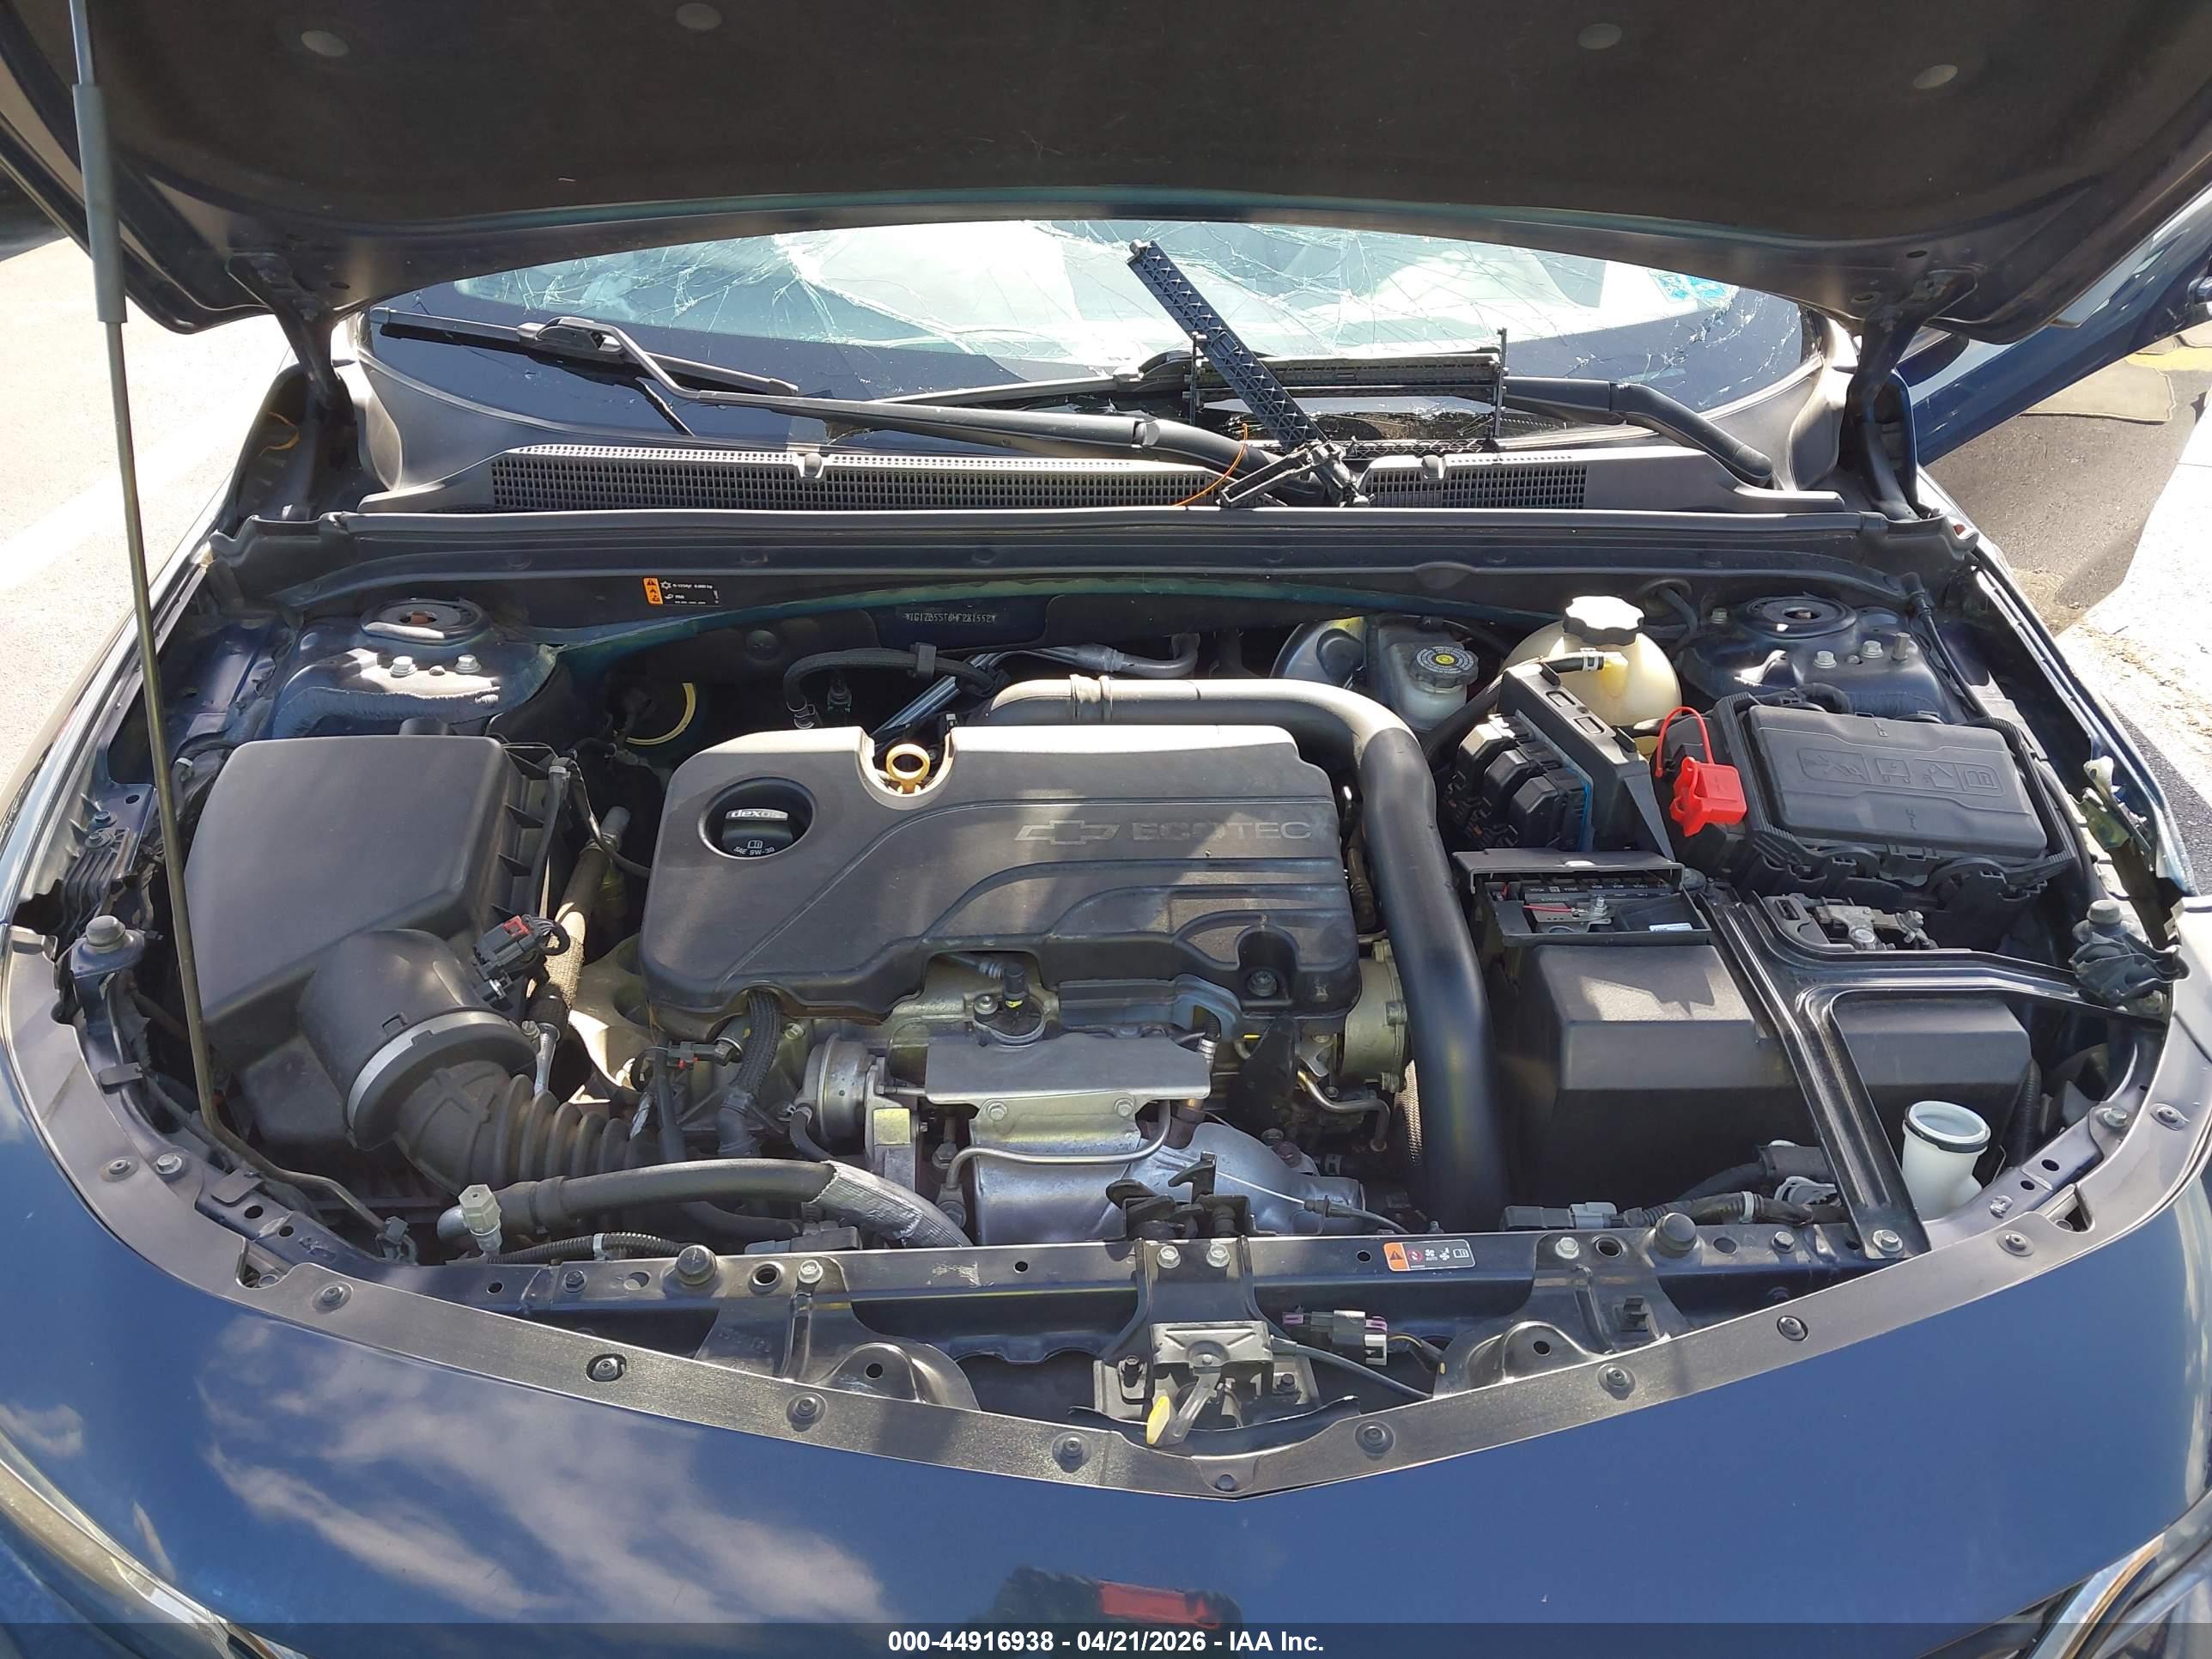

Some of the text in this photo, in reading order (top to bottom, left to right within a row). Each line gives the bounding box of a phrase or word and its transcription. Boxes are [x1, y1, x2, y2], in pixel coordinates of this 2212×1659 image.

[1132, 821, 1314, 842] ECOTEC
[733, 846, 775, 855] SAE 5W-30
